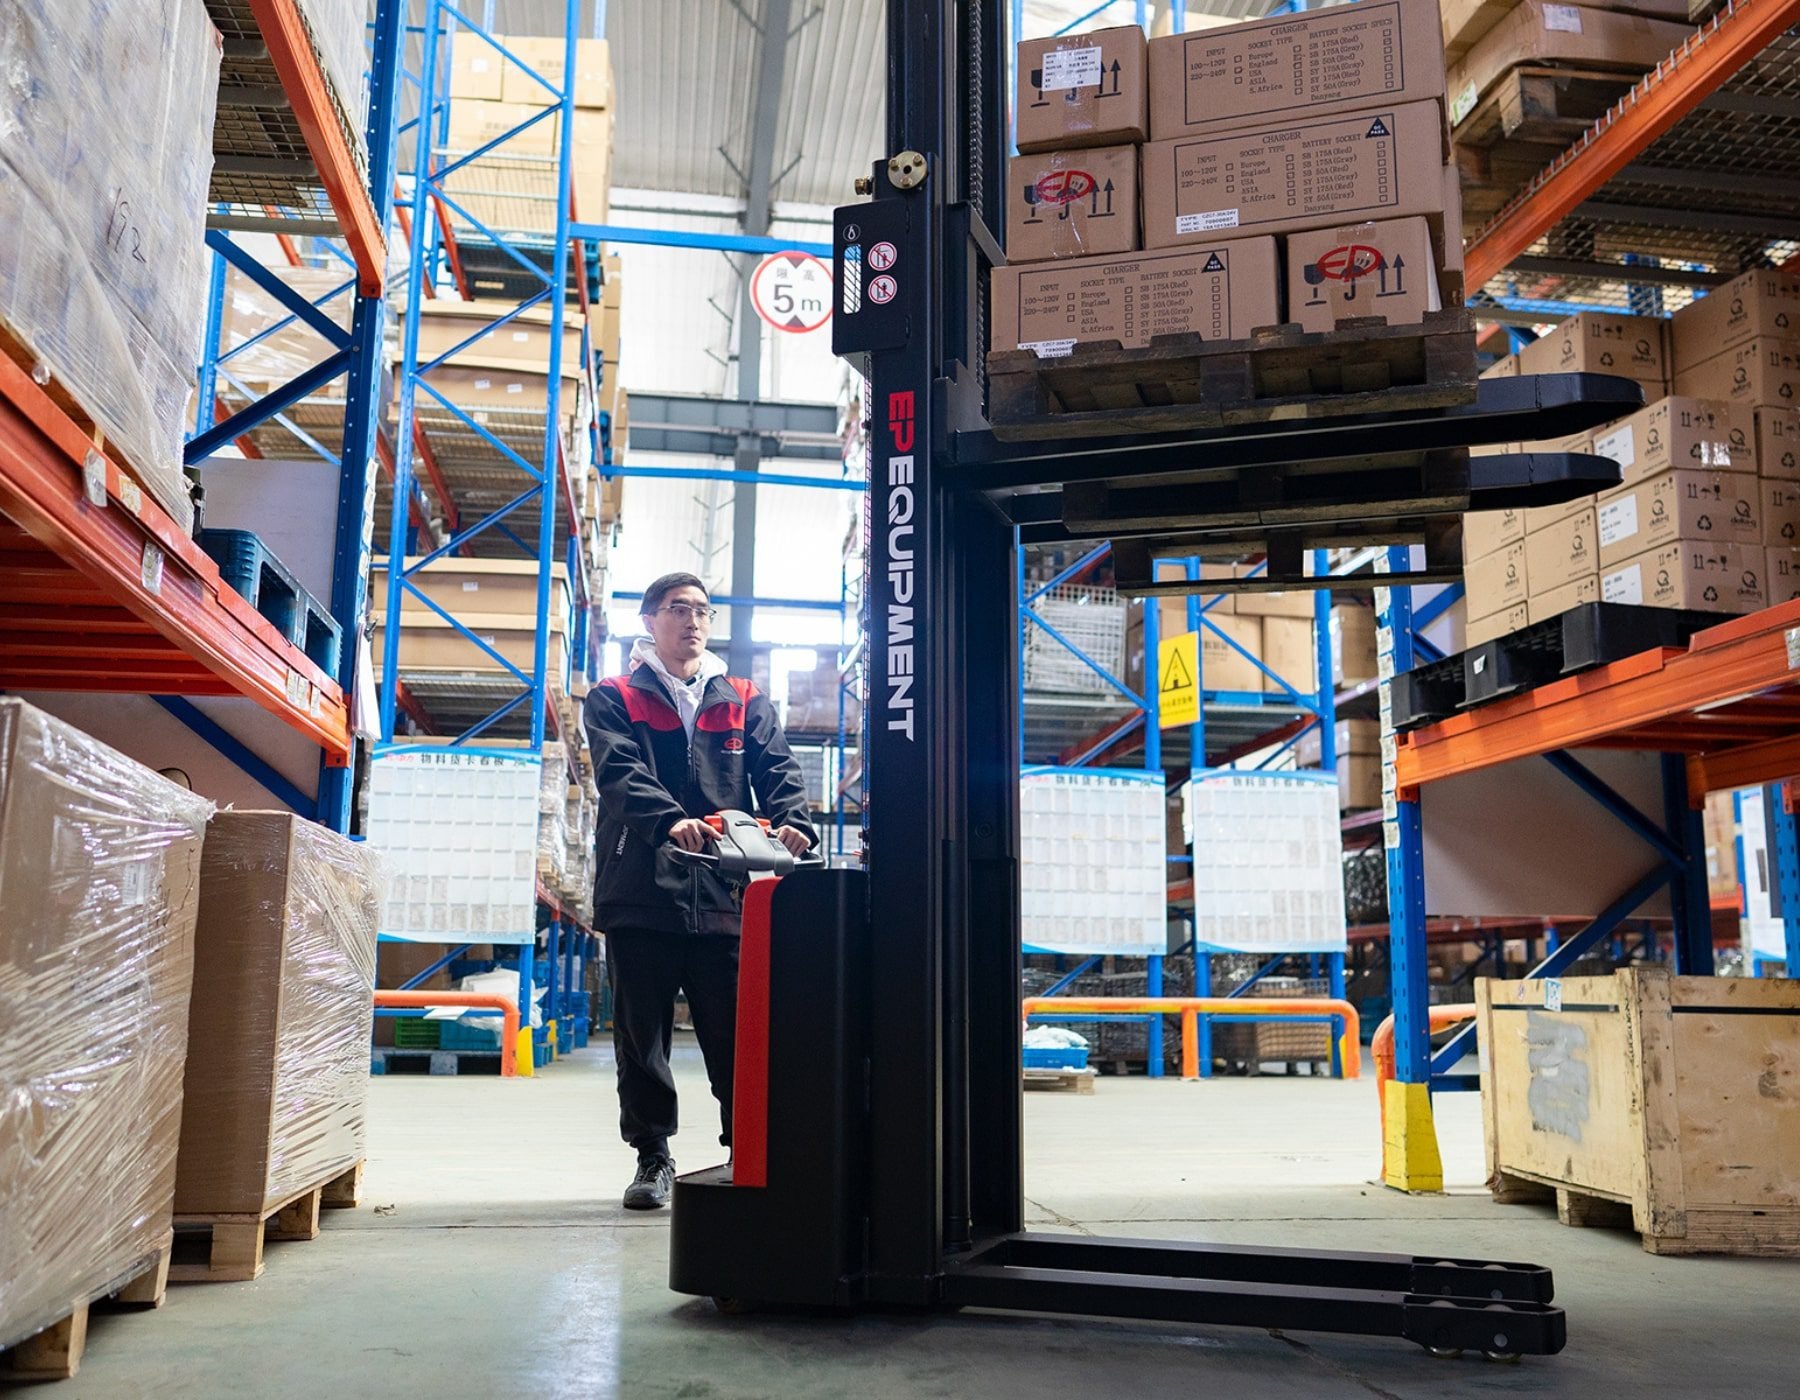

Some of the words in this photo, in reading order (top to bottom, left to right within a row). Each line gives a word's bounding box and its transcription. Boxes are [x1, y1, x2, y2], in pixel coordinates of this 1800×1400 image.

[1270, 22, 1309, 36] CHARGER
[1309, 28, 1339, 39] BATTERY
[1342, 22, 1368, 33] SOCKET
[1248, 40, 1272, 50] SOCKET
[1277, 36, 1293, 45] TYPE
[1206, 47, 1226, 57] INPUT
[1249, 52, 1273, 61] Europe
[1249, 59, 1278, 69] England
[1249, 77, 1266, 85] ASIA
[1262, 131, 1301, 144] CHARGER
[1302, 138, 1331, 149] BATTERY
[1336, 133, 1361, 144] SOCKET
[1240, 148, 1264, 158] SOCKET
[1268, 145, 1285, 154] TYPE
[1197, 154, 1216, 164] INPUT
[1241, 160, 1265, 169] Europe
[1241, 167, 1270, 177] England
[1241, 178, 1254, 186] USA
[1241, 186, 1258, 194] ASIA
[1102, 264, 1140, 276] CHARGER
[1140, 271, 1169, 281] BATTERY
[1172, 267, 1198, 277] SOCKET
[1040, 283, 1059, 292] INPUT
[1080, 279, 1105, 288] SOCKET
[1108, 277, 1125, 285] TYPE
[1081, 291, 1106, 300] Europe
[1081, 299, 1110, 308] England
[888, 391, 914, 452] EP
[887, 455, 914, 742] EQUIPMENT
